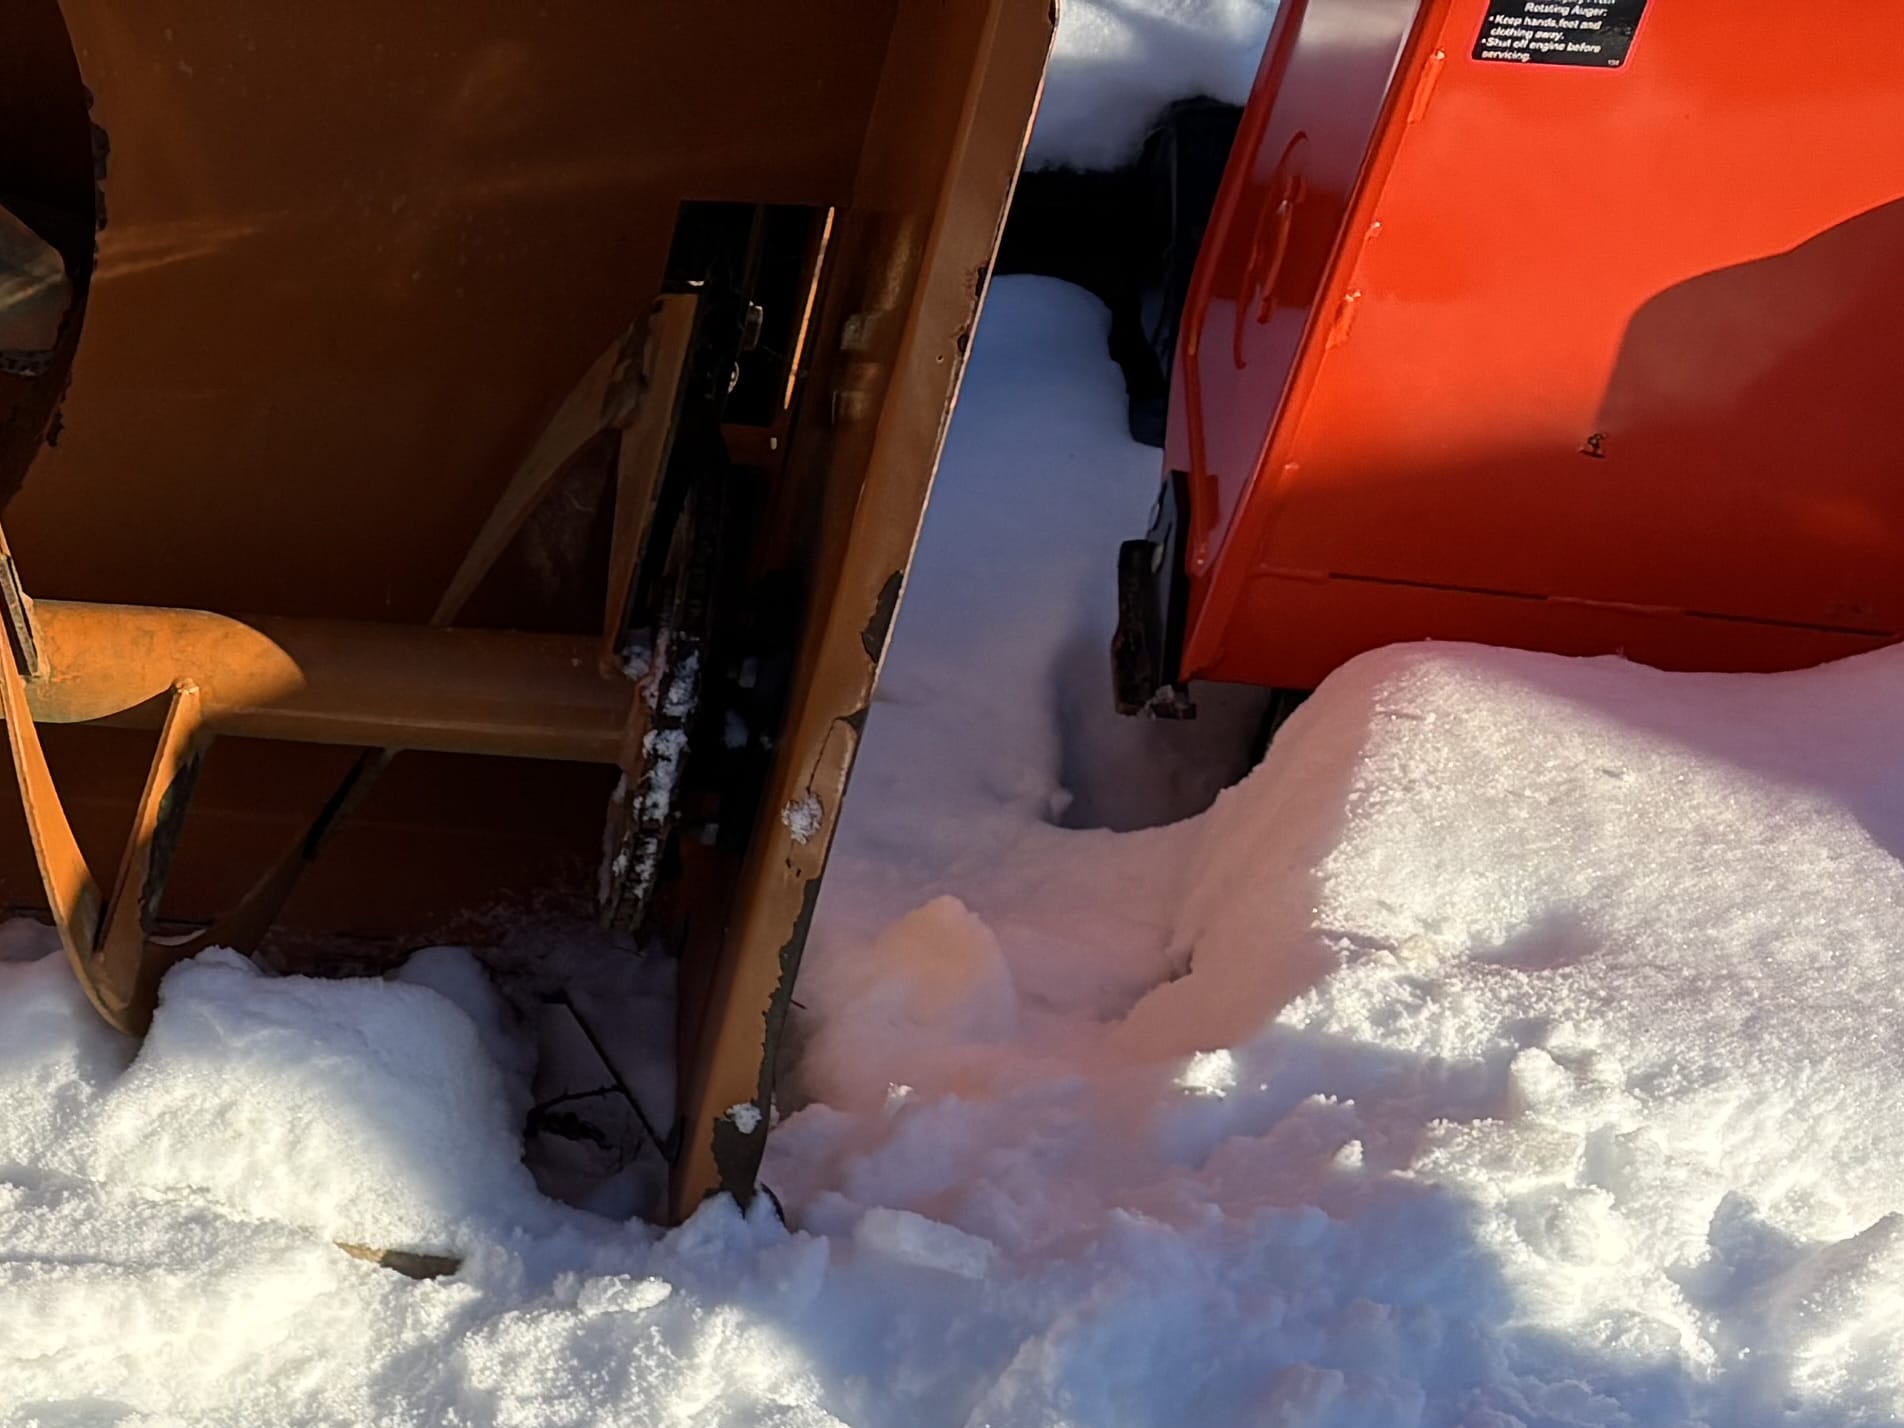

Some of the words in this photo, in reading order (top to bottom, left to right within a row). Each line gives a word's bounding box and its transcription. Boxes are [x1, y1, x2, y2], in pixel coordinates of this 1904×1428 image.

[1524, 2, 1570, 16] Rotating
[1494, 14, 1522, 26] Keep
[1580, 21, 1602, 30] and
[1490, 26, 1533, 40] clothing
[1534, 31, 1565, 41] away.
[1486, 37, 1512, 47] Shut
[1513, 39, 1529, 48] off
[1529, 41, 1566, 52] engine
[1567, 42, 1602, 53] before
